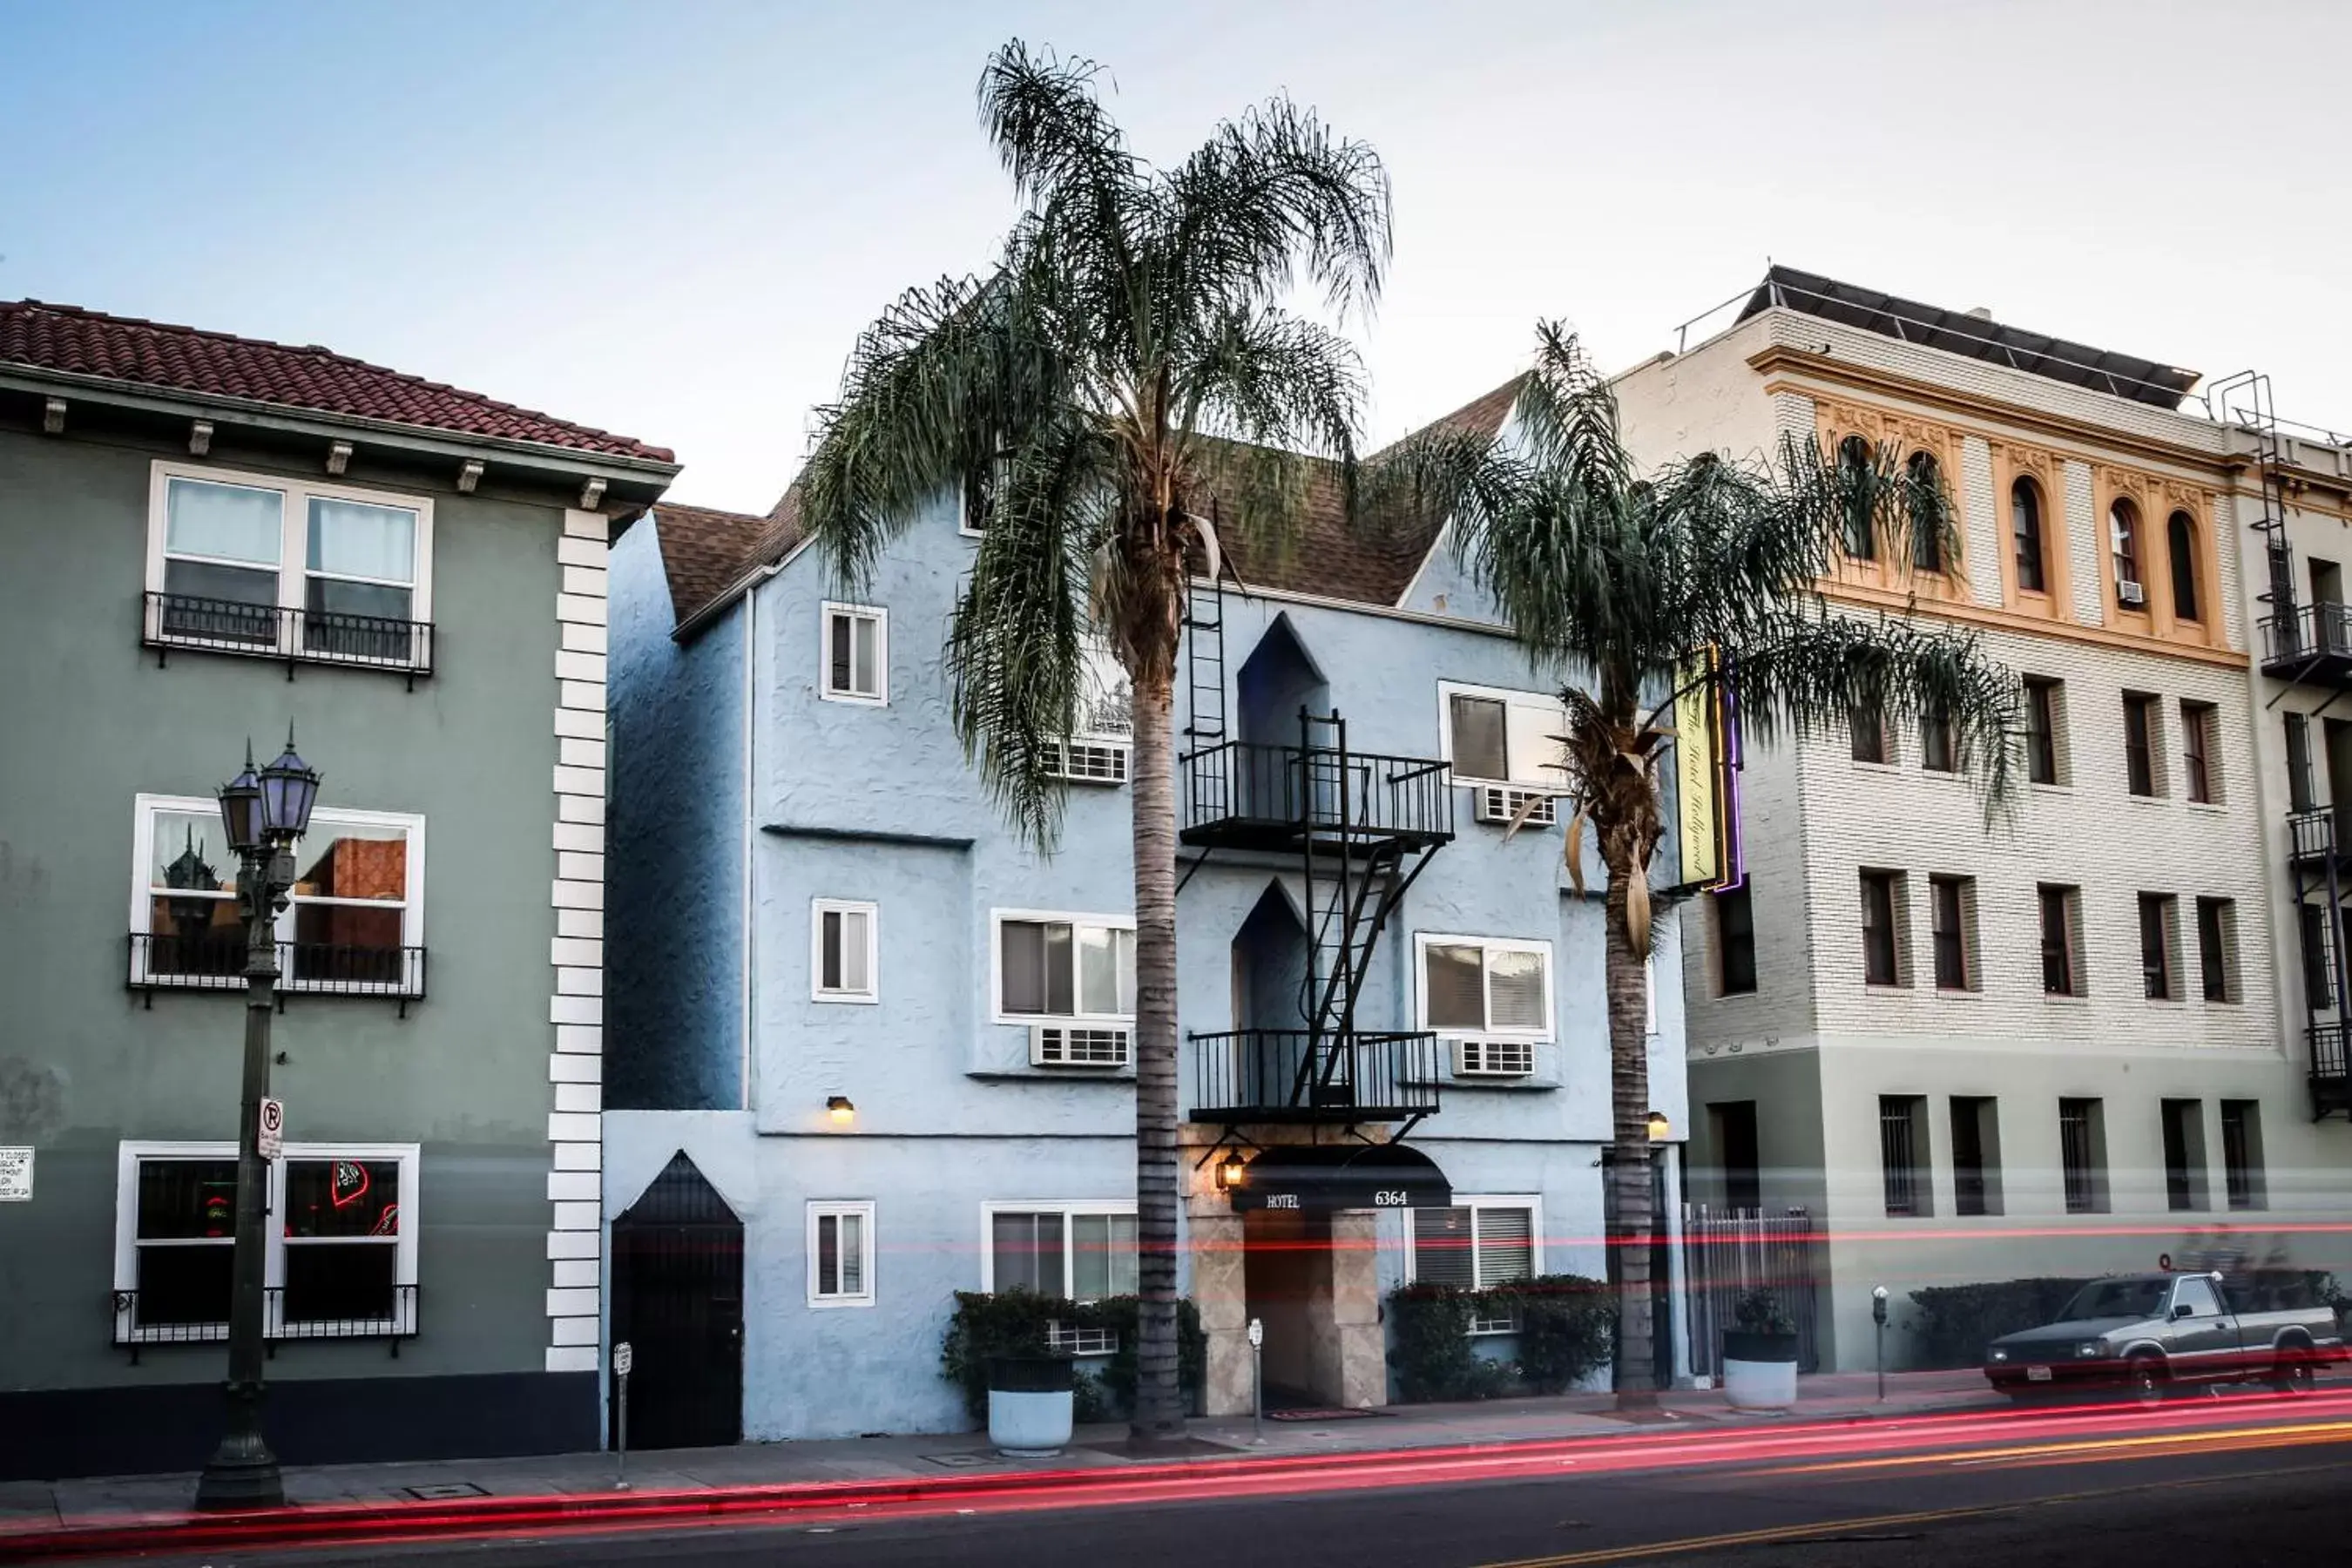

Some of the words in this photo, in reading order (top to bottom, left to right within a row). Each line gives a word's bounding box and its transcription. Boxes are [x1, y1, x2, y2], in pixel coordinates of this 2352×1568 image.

[1688, 739, 1704, 789] Hotel
[1686, 794, 1707, 876] Hollywood
[1267, 1194, 1300, 1209] HOTEL
[1375, 1191, 1407, 1206] 6364
